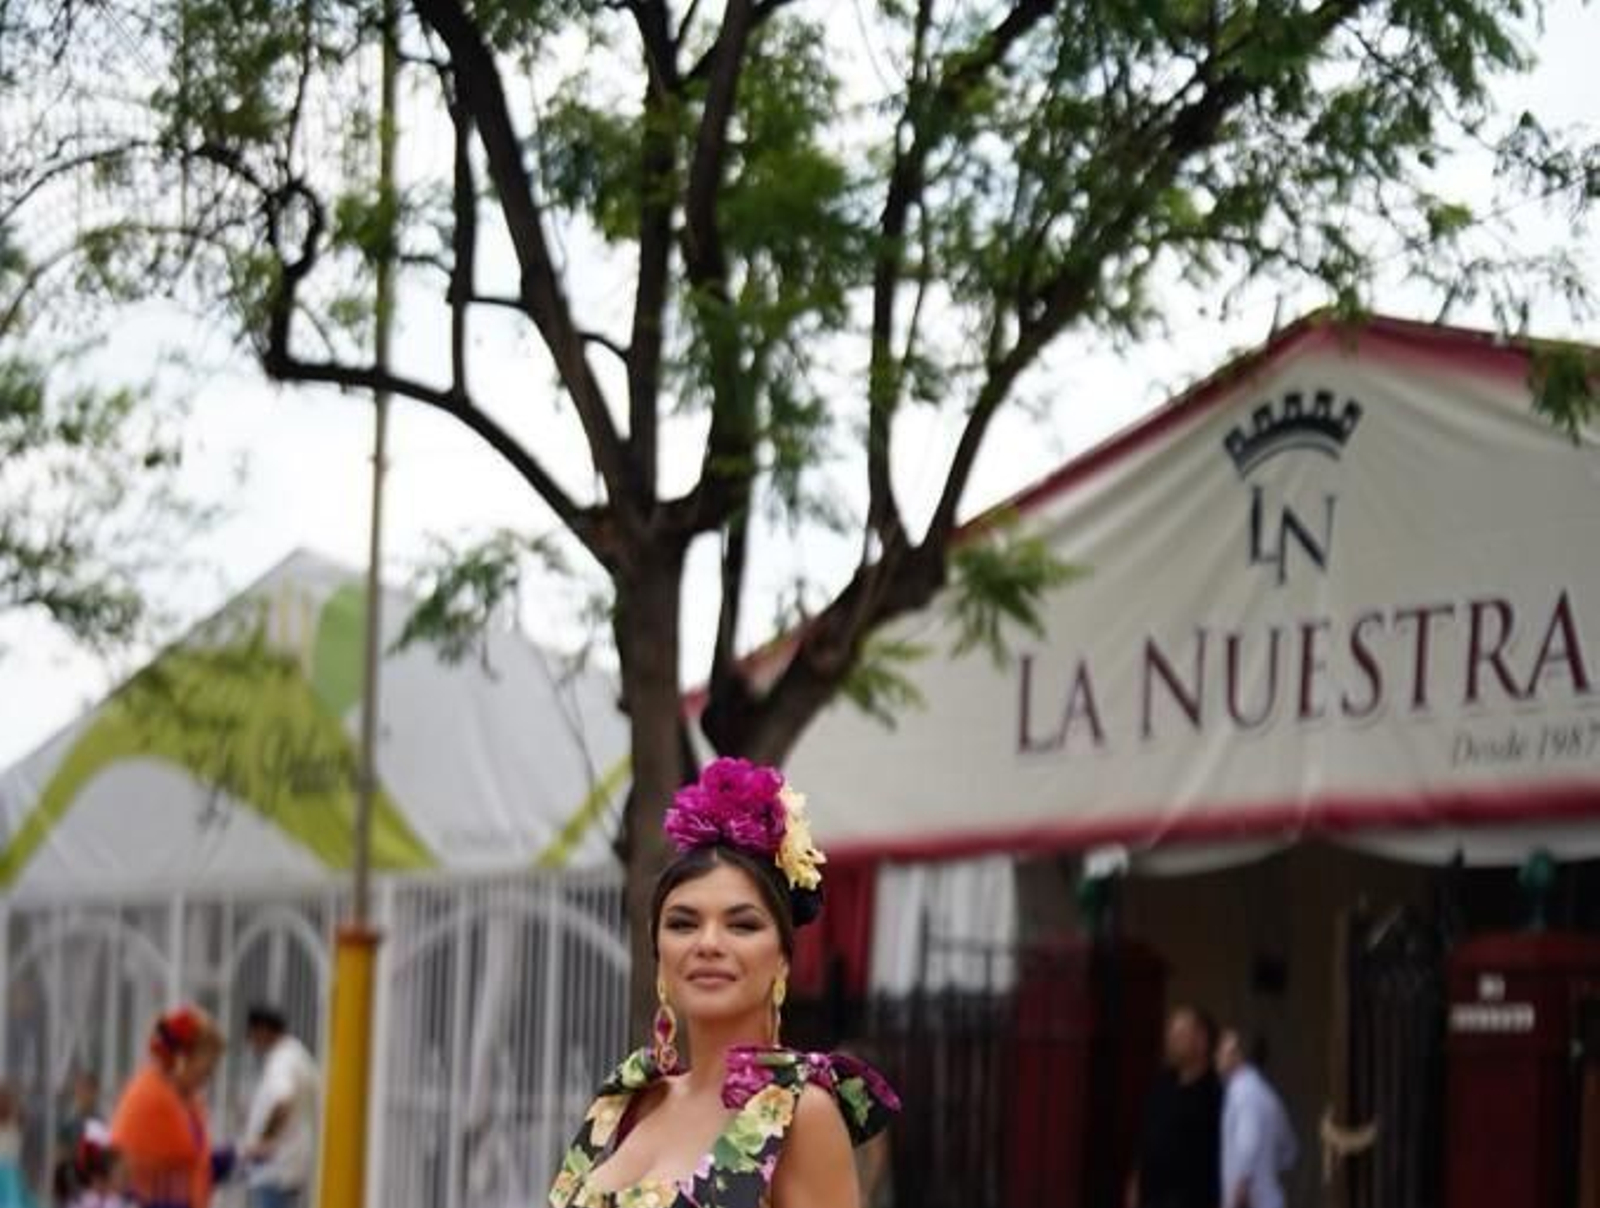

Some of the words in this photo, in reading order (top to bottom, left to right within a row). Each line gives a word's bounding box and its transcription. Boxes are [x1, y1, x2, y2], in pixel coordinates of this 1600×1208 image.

[1247, 484, 1337, 586] LN
[1017, 653, 1105, 755] LA
[1140, 586, 1592, 742] NUESTRA
